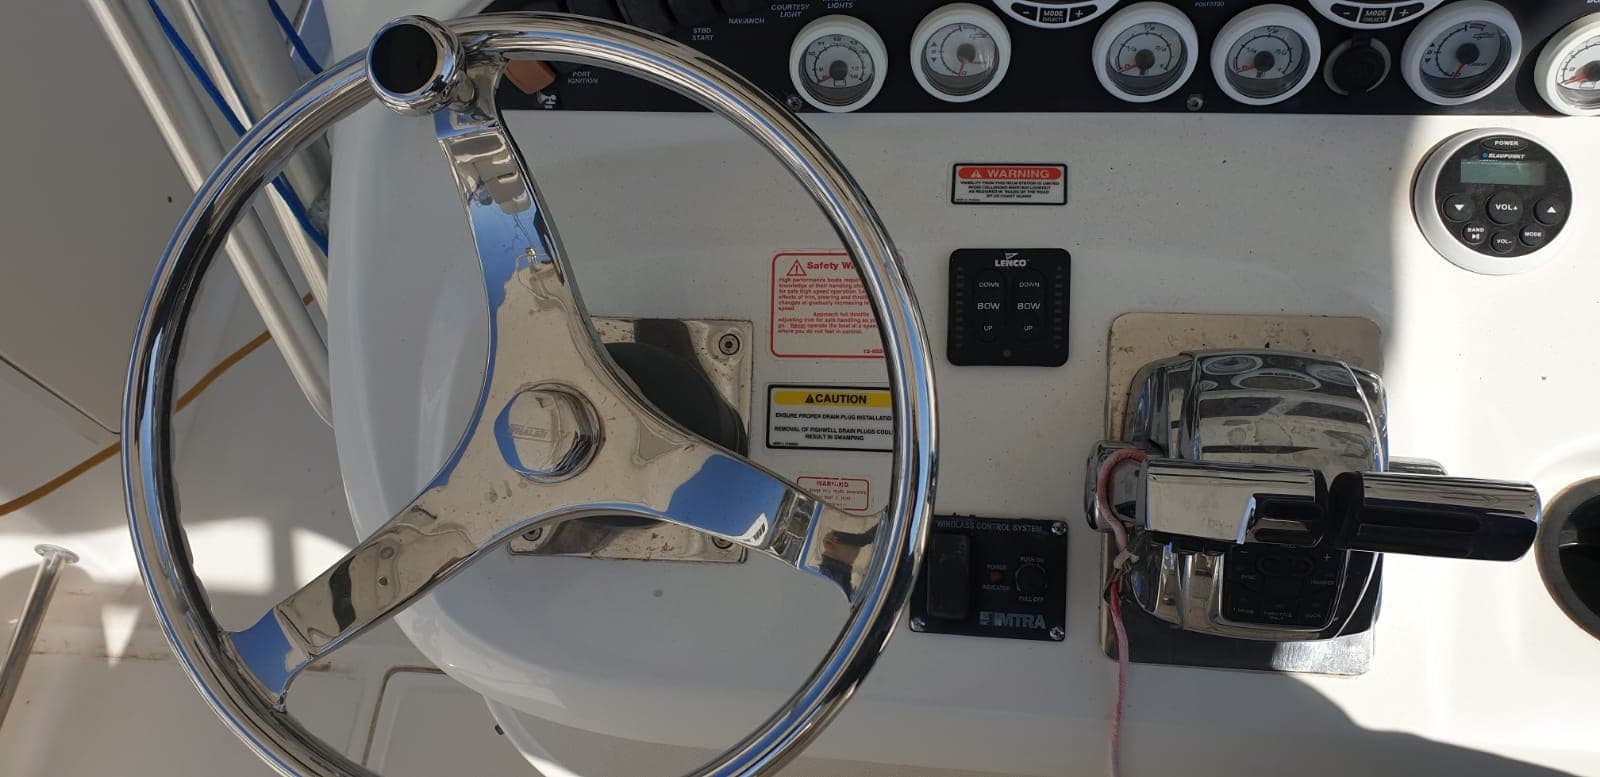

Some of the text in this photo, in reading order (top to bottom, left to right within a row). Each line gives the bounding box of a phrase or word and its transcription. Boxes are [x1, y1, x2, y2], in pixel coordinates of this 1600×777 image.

[771, 3, 810, 11] COURTESY
[987, 170, 1050, 178] WARNING
[1495, 203, 1518, 211] VOL+
[806, 262, 838, 270] Safety
[994, 259, 1027, 268] LENCO
[977, 302, 1000, 310] BOW
[1017, 302, 1041, 310] BOW
[815, 394, 867, 404] CAUTION
[936, 519, 1042, 533] WINDLASS CONTROL SYSTEM
[992, 612, 1046, 630] IMTRA
